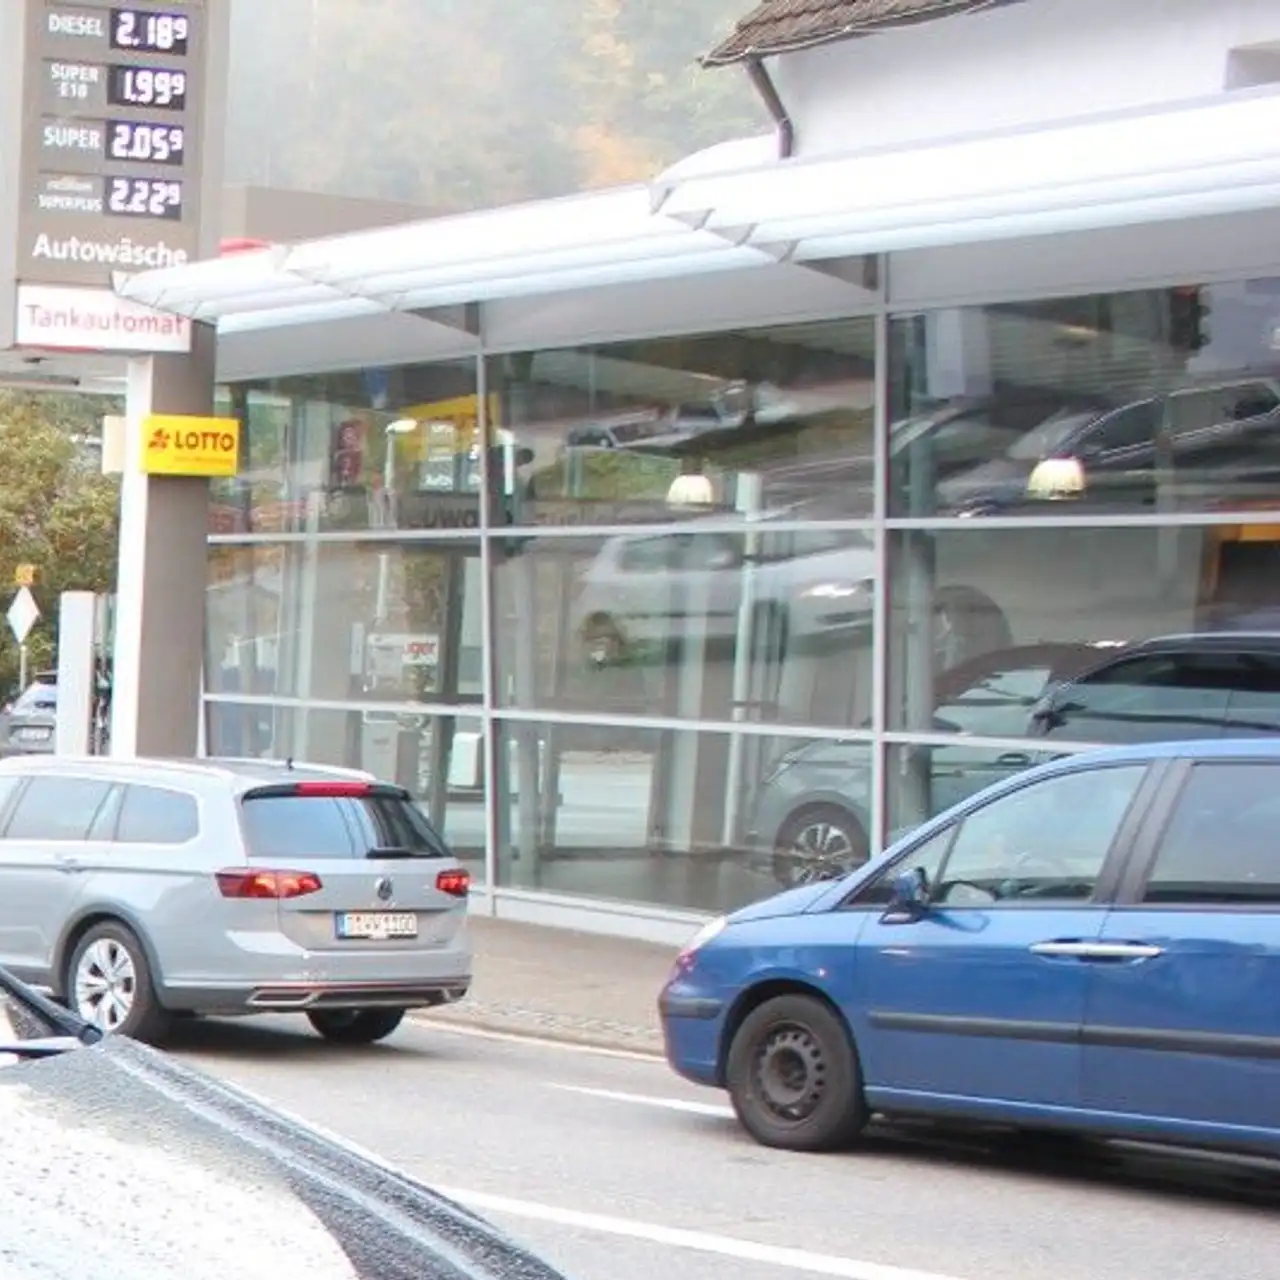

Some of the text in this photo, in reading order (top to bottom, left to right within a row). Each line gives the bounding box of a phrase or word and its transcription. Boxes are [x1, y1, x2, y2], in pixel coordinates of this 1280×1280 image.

[48, 13, 104, 37] DIESEL
[51, 63, 98, 83] SUPER
[59, 83, 88, 99] E10
[44, 126, 100, 149] SUPER
[32, 233, 188, 270] Autowäsche
[24, 304, 185, 335] Tankautomat
[174, 430, 235, 452] LOTTO
